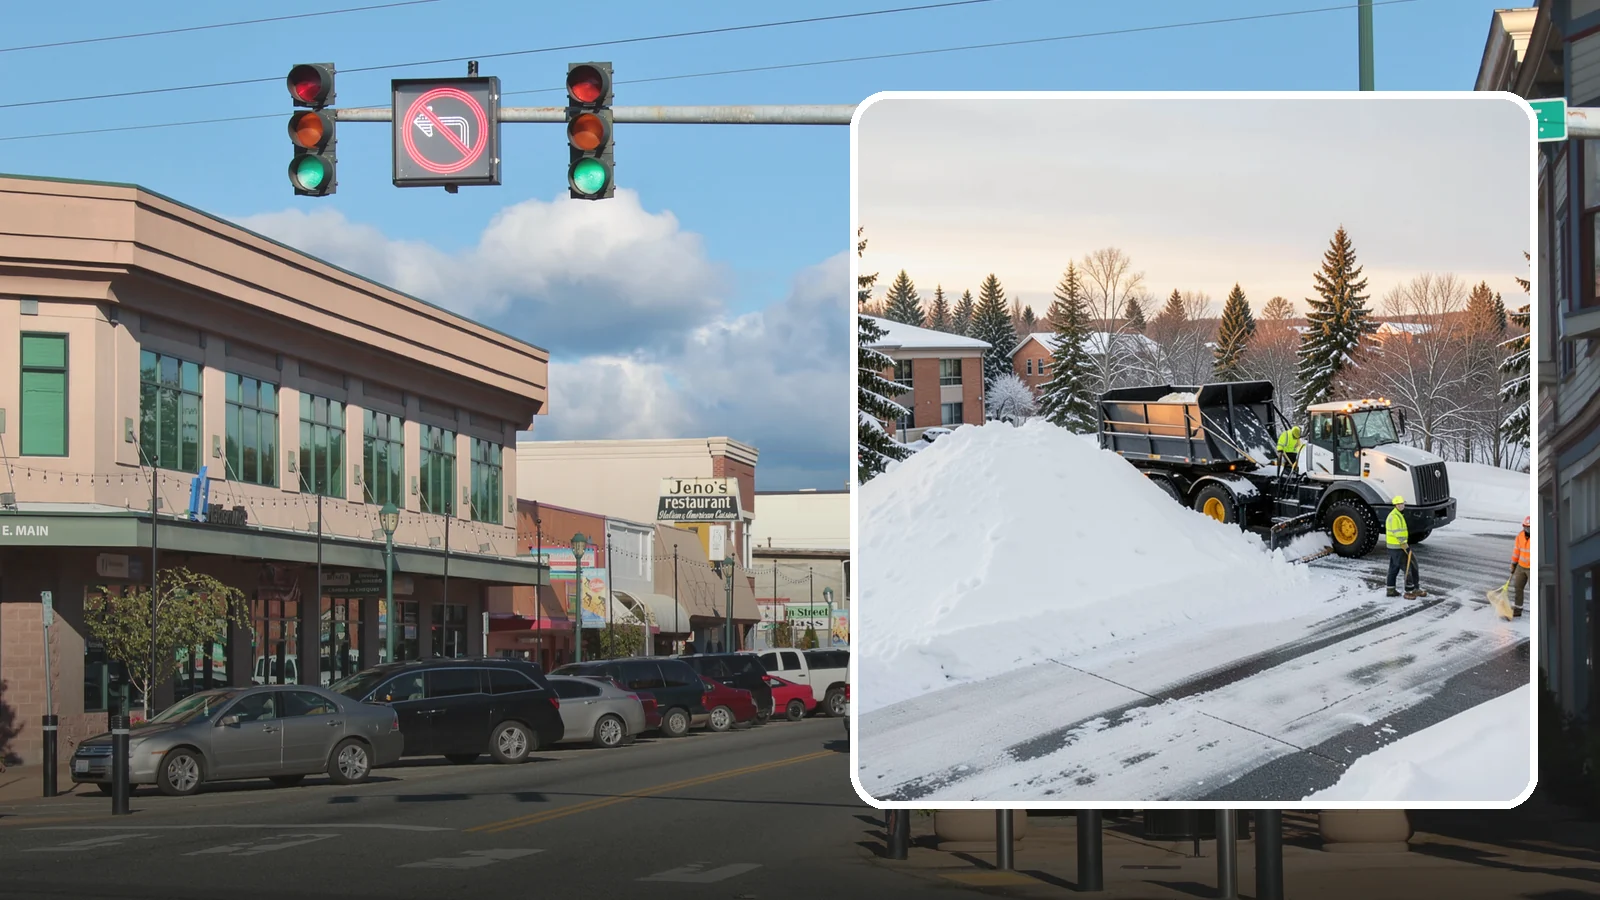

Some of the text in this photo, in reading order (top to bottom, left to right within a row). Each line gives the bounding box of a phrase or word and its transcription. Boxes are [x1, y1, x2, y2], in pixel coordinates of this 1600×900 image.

[669, 480, 728, 495] Jeno's
[665, 496, 731, 509] restaurant
[658, 509, 681, 519] Italian
[686, 509, 715, 519] American
[715, 509, 737, 519] Cuisine
[2, 525, 49, 536] E. MAIN
[797, 607, 829, 616] Street
[791, 619, 824, 627] lass
